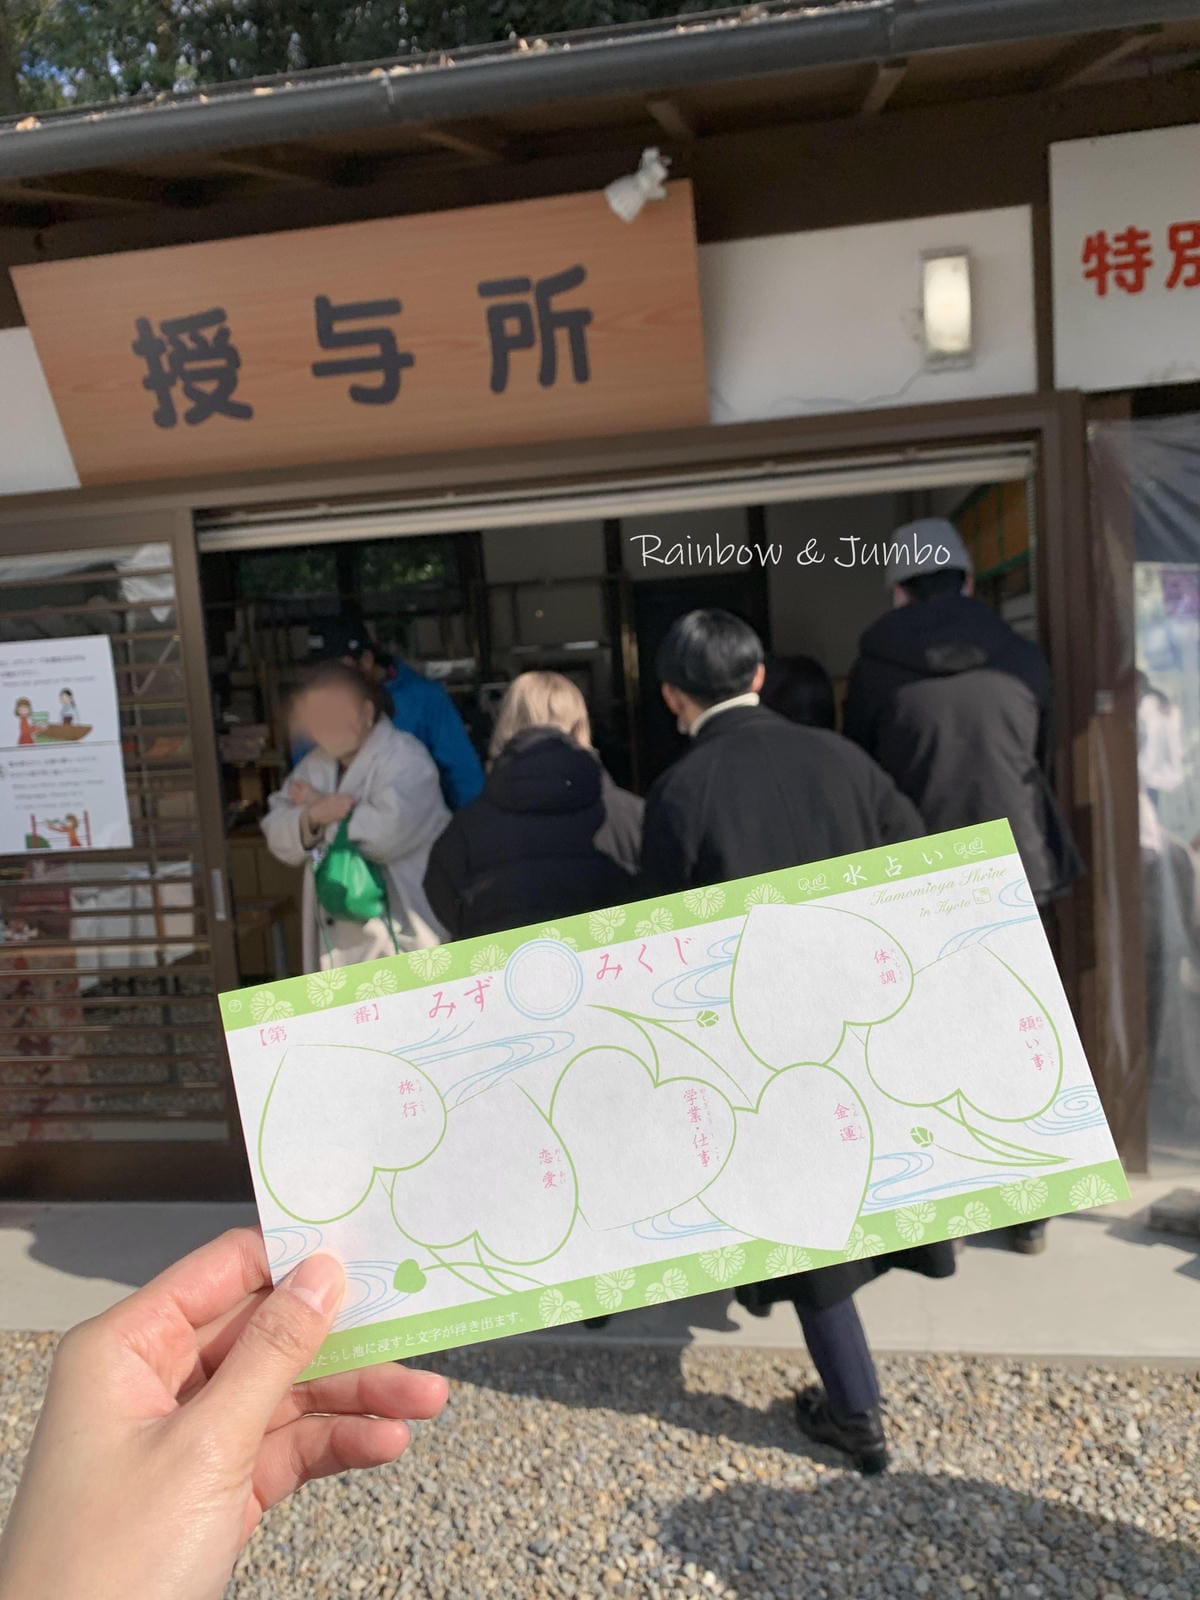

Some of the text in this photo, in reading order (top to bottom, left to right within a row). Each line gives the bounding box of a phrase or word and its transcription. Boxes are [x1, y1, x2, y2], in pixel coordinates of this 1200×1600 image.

[133, 265, 593, 428] 授与所
[843, 850, 944, 886] 水占い
[959, 866, 1007, 886] Shrine
[919, 898, 971, 918] in Kyoto
[428, 937, 692, 1019] みず みくじ
[873, 948, 897, 985] 体調
[1018, 1015, 1044, 1071] 願い事
[399, 1079, 417, 1118] 旅行
[833, 1103, 858, 1141] 金運
[538, 1148, 558, 1189] 恋愛
